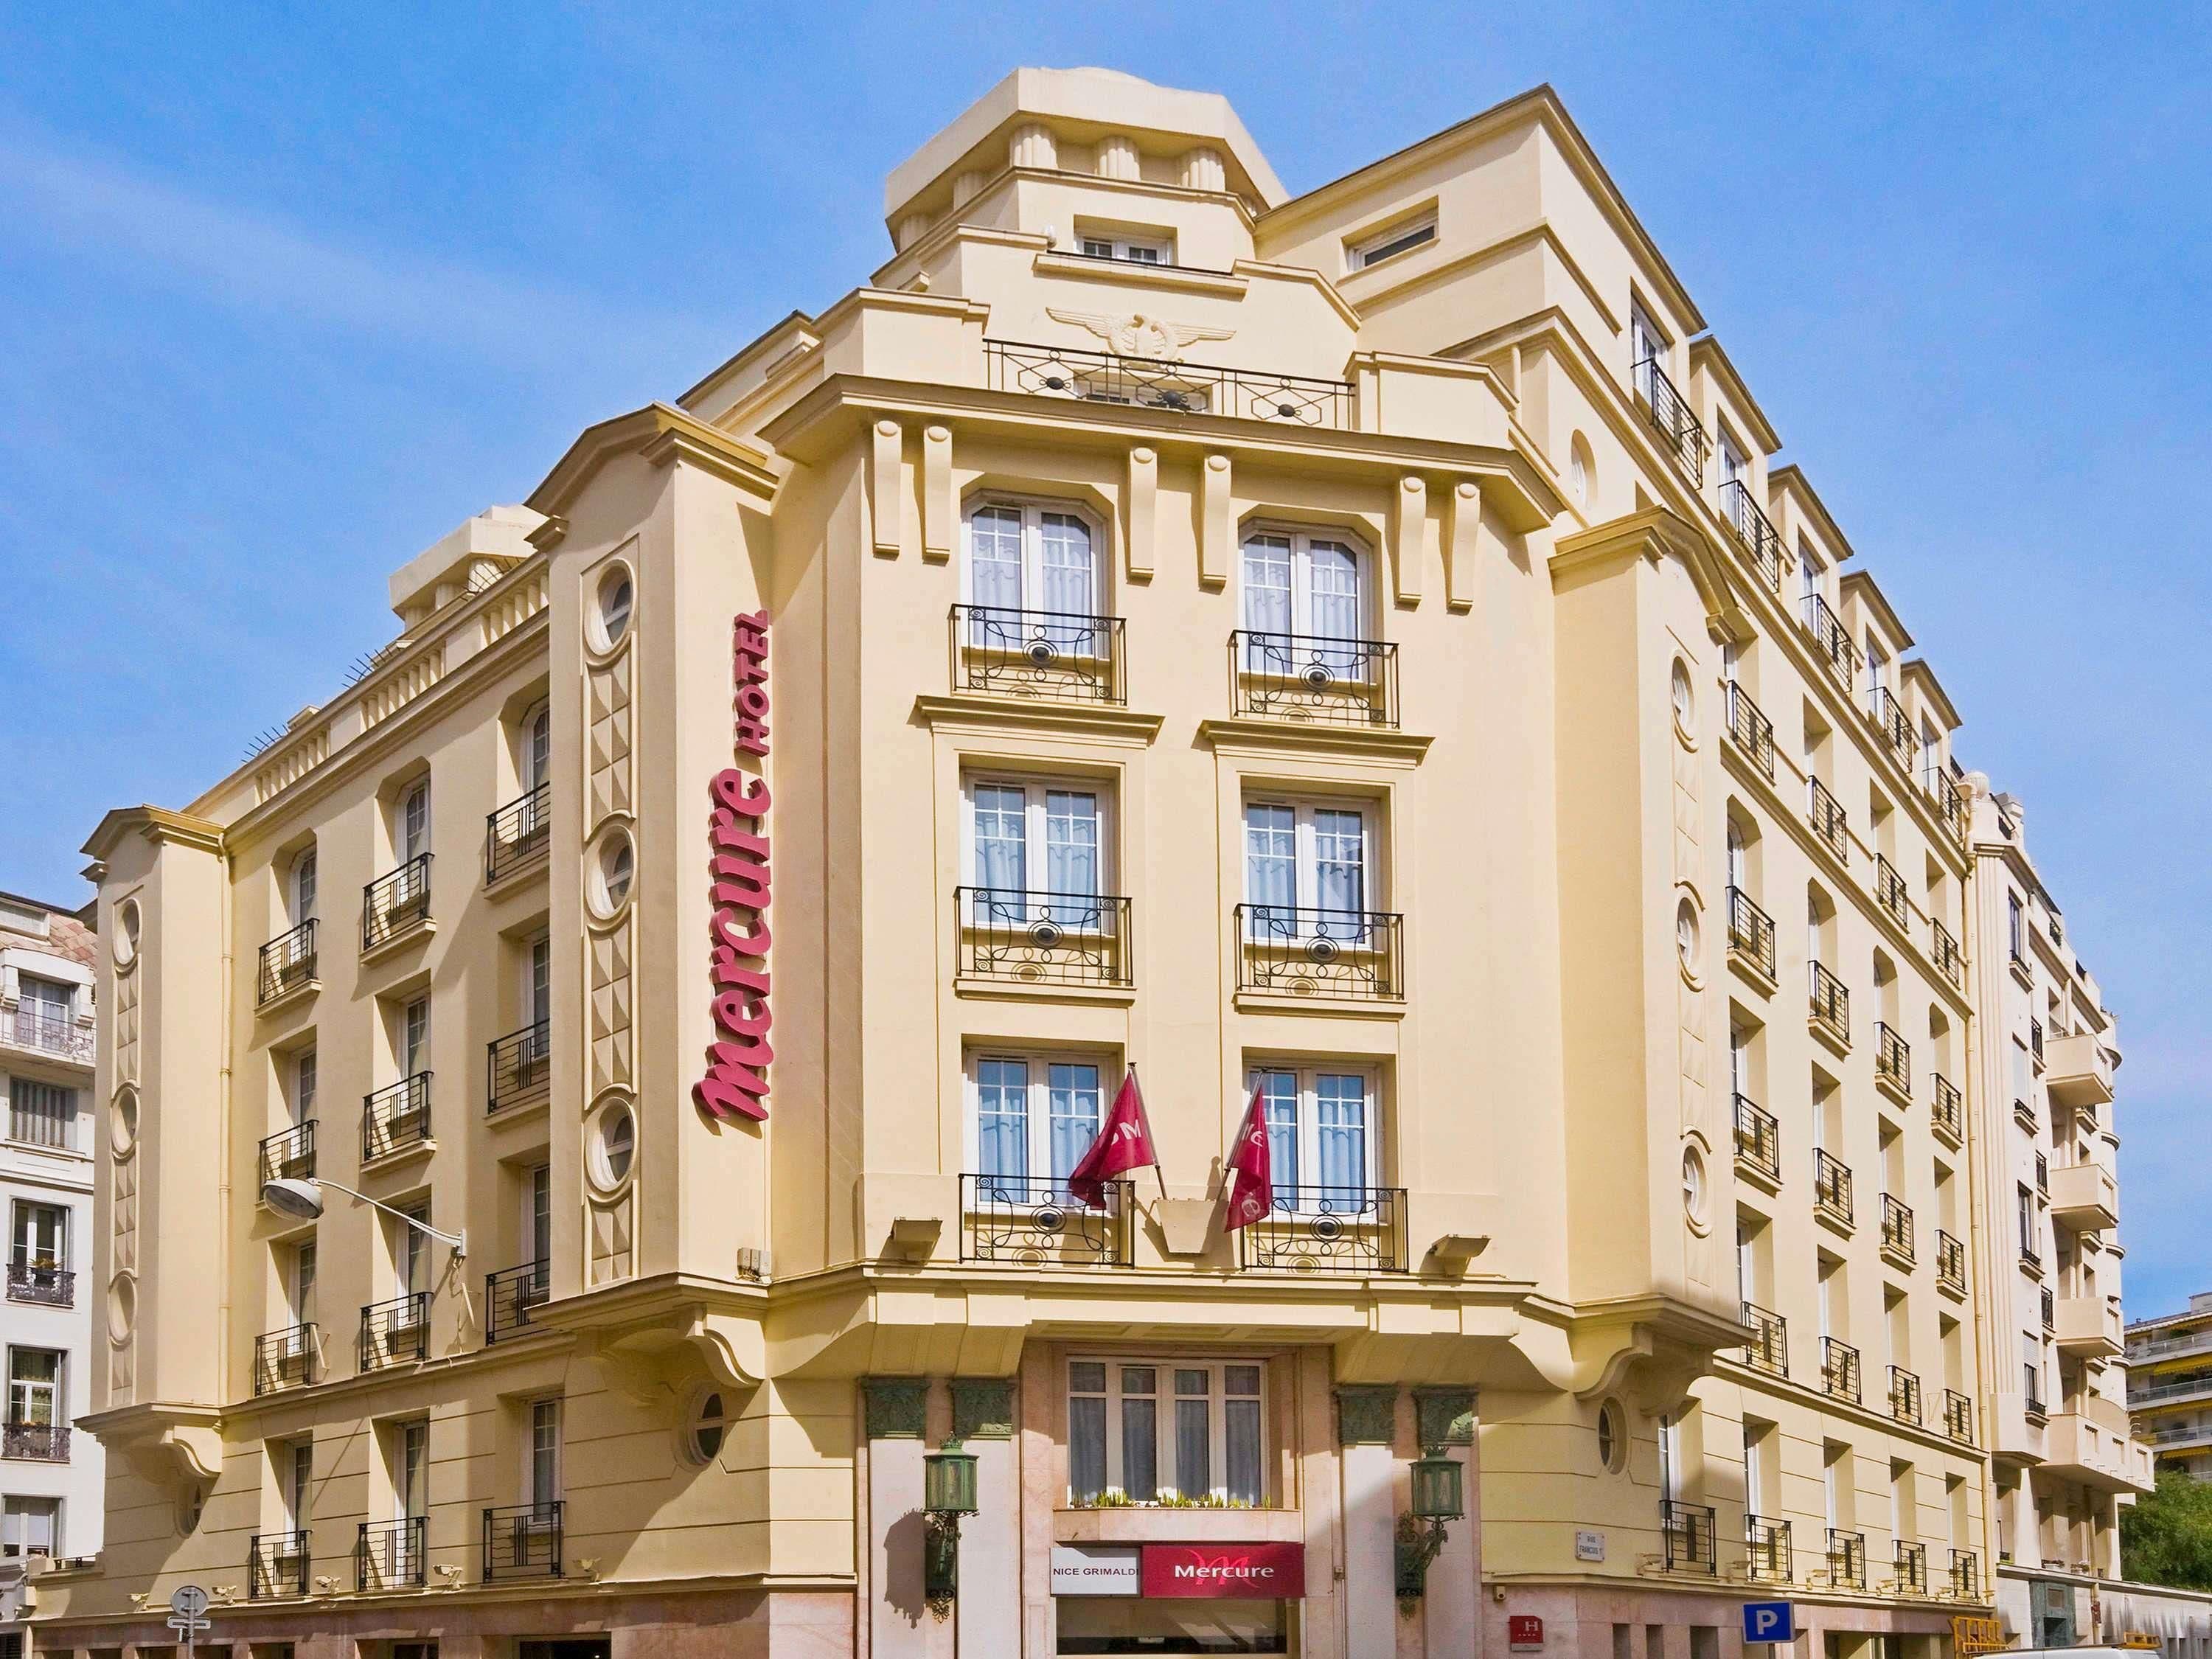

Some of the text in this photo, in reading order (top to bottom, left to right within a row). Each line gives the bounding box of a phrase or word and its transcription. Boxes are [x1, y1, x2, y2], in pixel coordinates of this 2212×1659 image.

[734, 608, 771, 758] HOTEL
[1053, 1568, 1139, 1576] NICE GRIMALDI
[1174, 1565, 1275, 1578] Mercure
[1525, 1621, 1538, 1631] H
[1756, 1610, 1778, 1635] P
